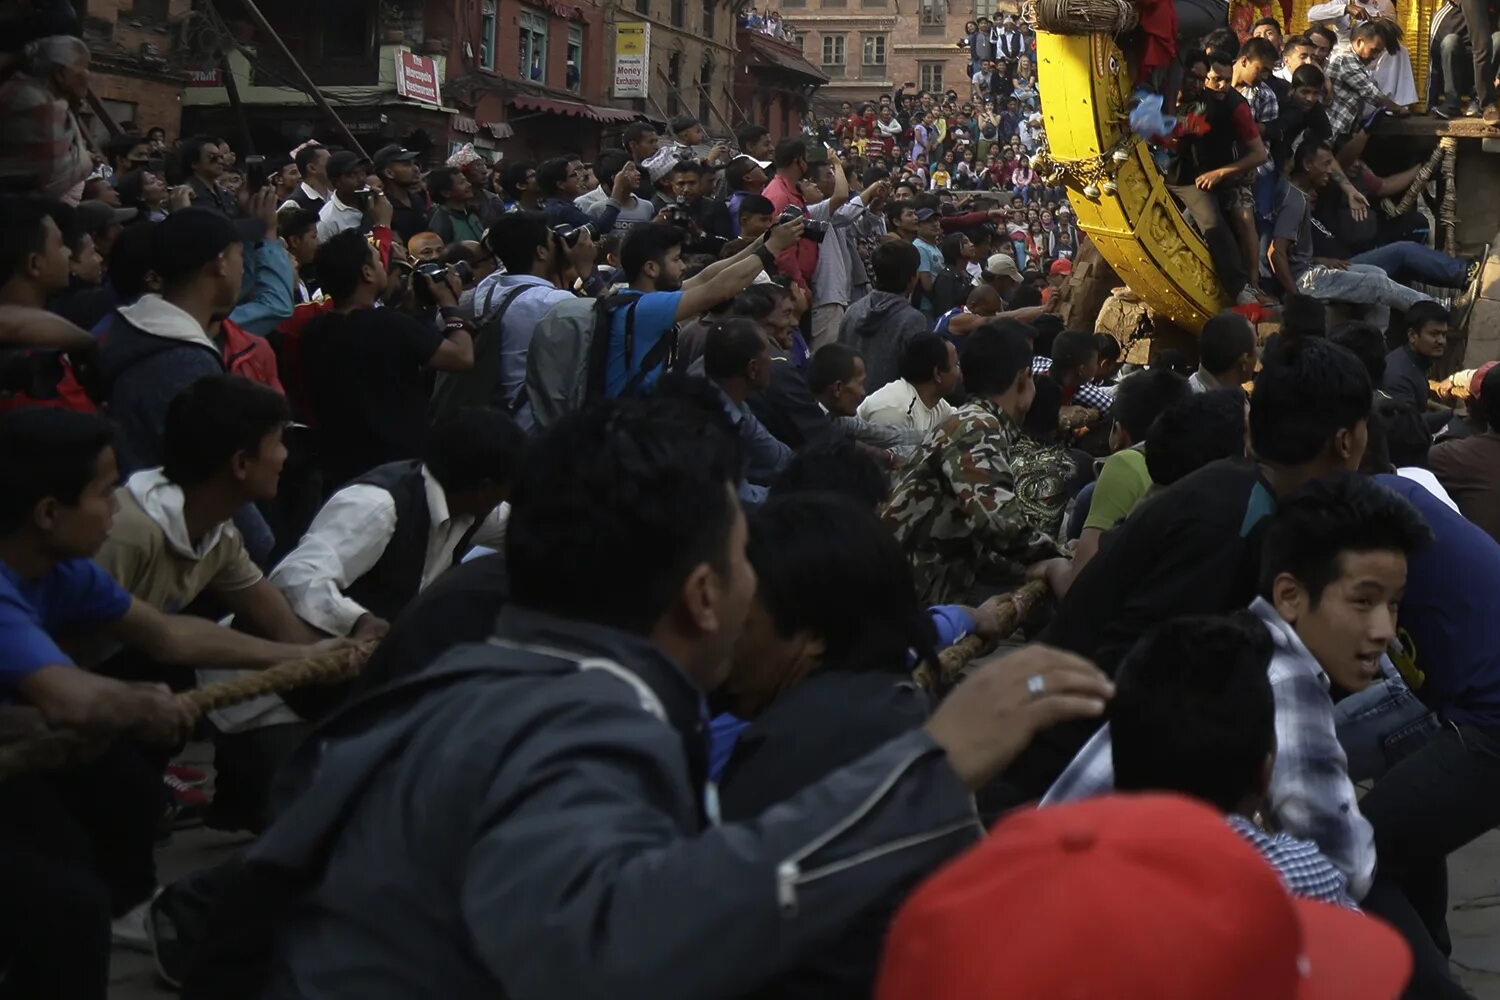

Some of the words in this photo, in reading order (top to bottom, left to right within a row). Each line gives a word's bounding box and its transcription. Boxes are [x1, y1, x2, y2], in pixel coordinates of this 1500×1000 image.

[412, 54, 423, 66] The
[617, 66, 641, 76] Money
[616, 77, 641, 87] Exchange
[406, 79, 436, 98] Restaurant
